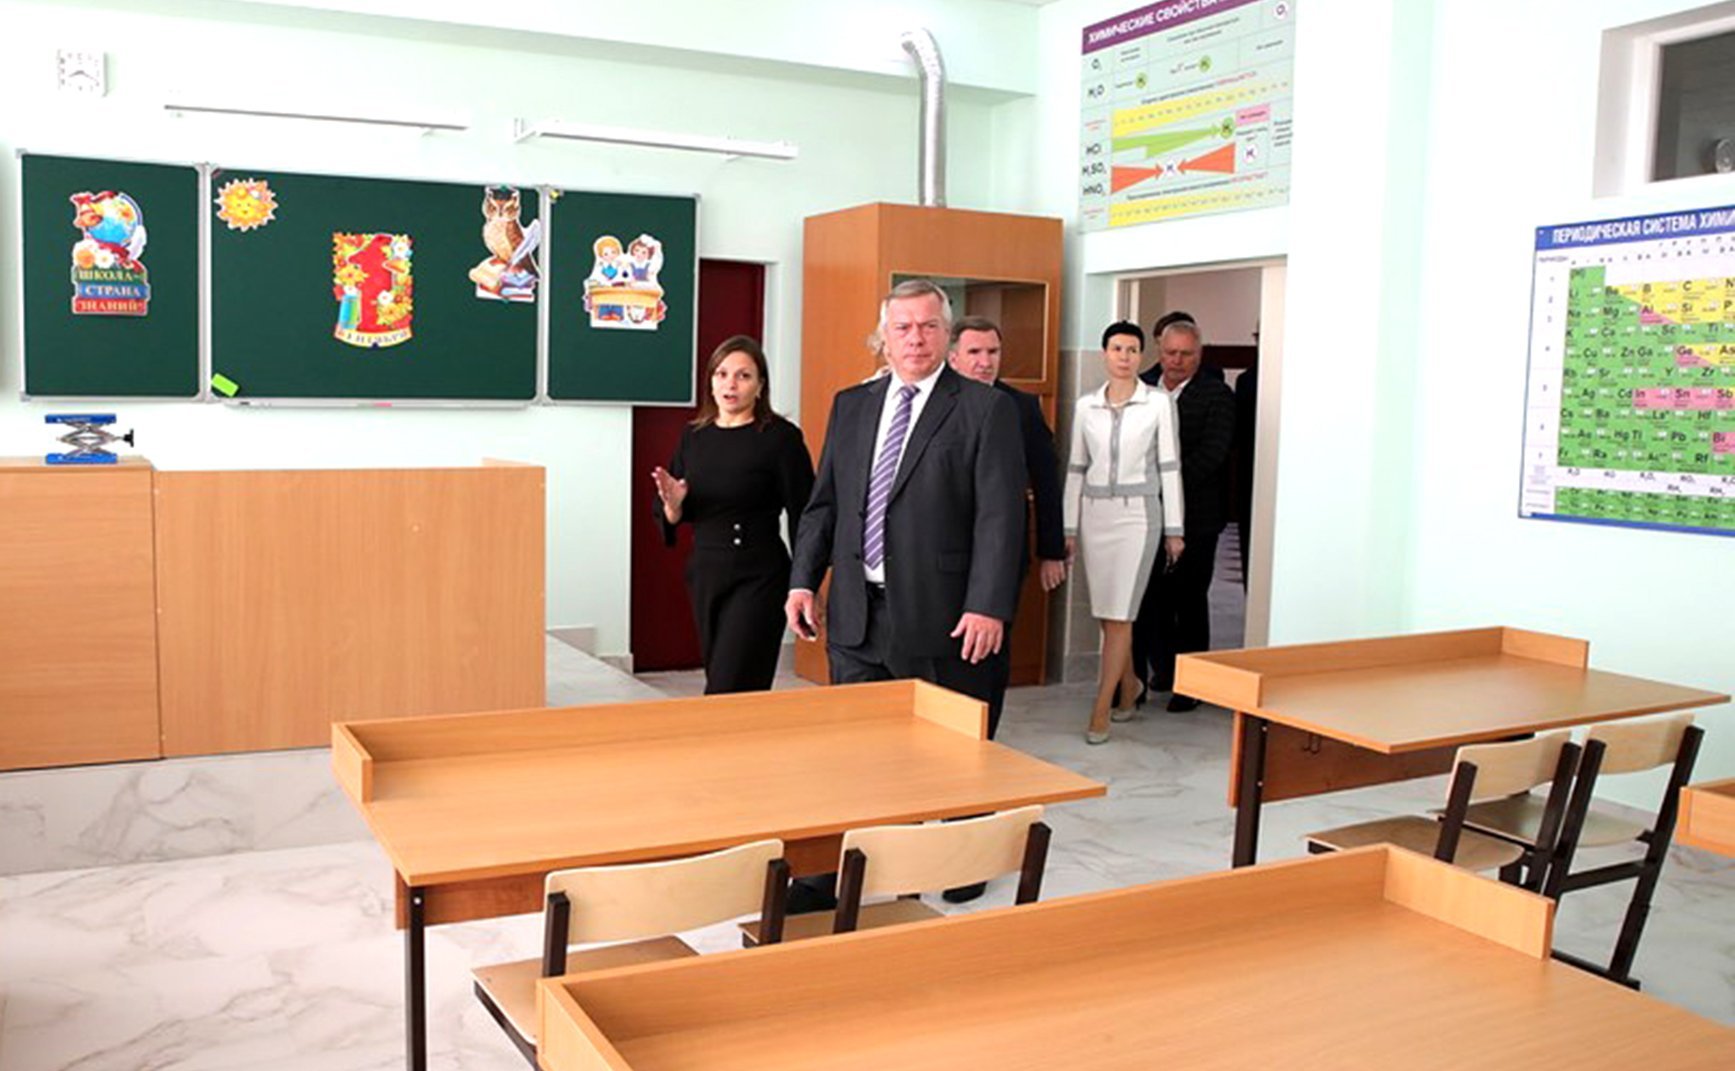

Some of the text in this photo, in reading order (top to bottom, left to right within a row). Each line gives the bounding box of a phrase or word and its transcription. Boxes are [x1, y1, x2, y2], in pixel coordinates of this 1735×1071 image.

[1553, 221, 1641, 243] ПЕРИОДИЧЕСКАЯ
[1643, 214, 1697, 235] СИСТЕМА
[85, 285, 141, 297] СТРАНА
[1683, 280, 1692, 291] C
[1675, 389, 1691, 398] Sn
[1717, 389, 1733, 399] Sb
